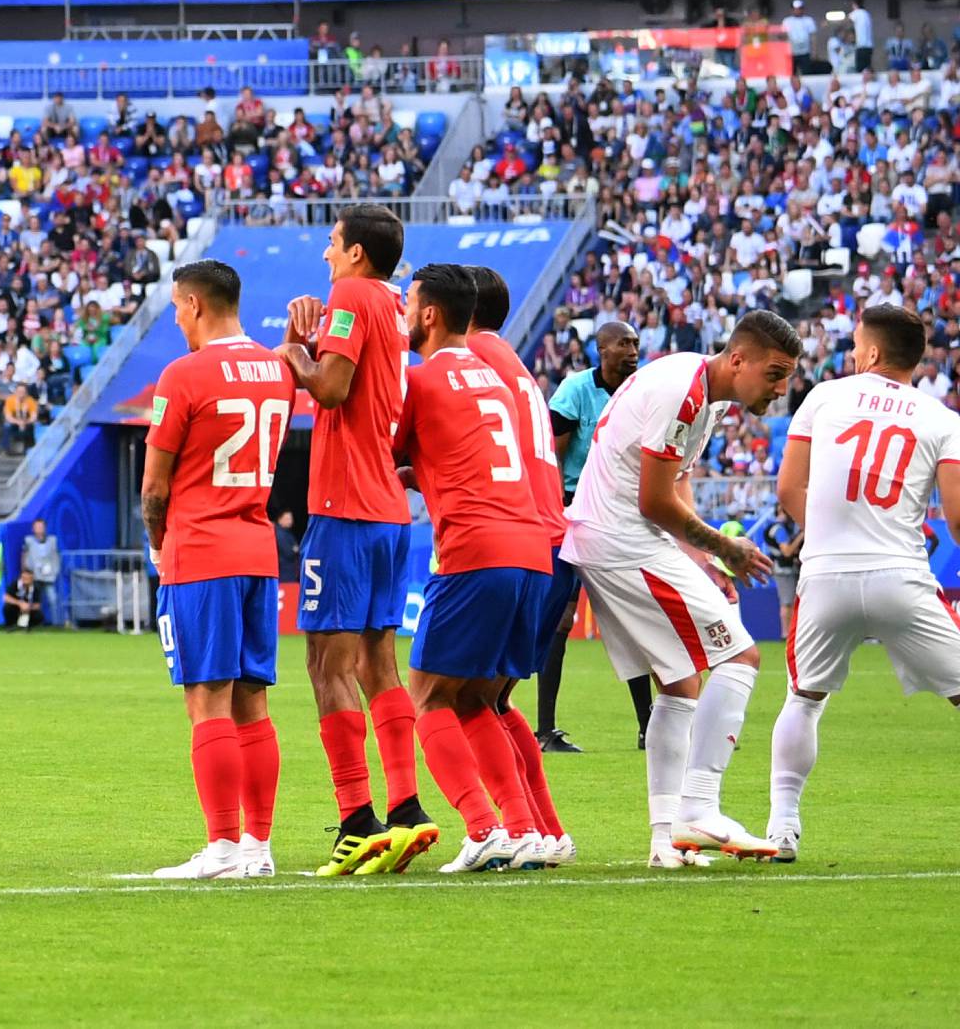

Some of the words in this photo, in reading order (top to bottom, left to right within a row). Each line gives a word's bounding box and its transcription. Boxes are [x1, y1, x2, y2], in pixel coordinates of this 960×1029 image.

[458, 227, 551, 249] FIFA
[857, 392, 917, 416] TADIC
[212, 398, 290, 487] 20
[477, 399, 522, 482] 3
[835, 419, 917, 510] 10
[304, 559, 323, 596] 5
